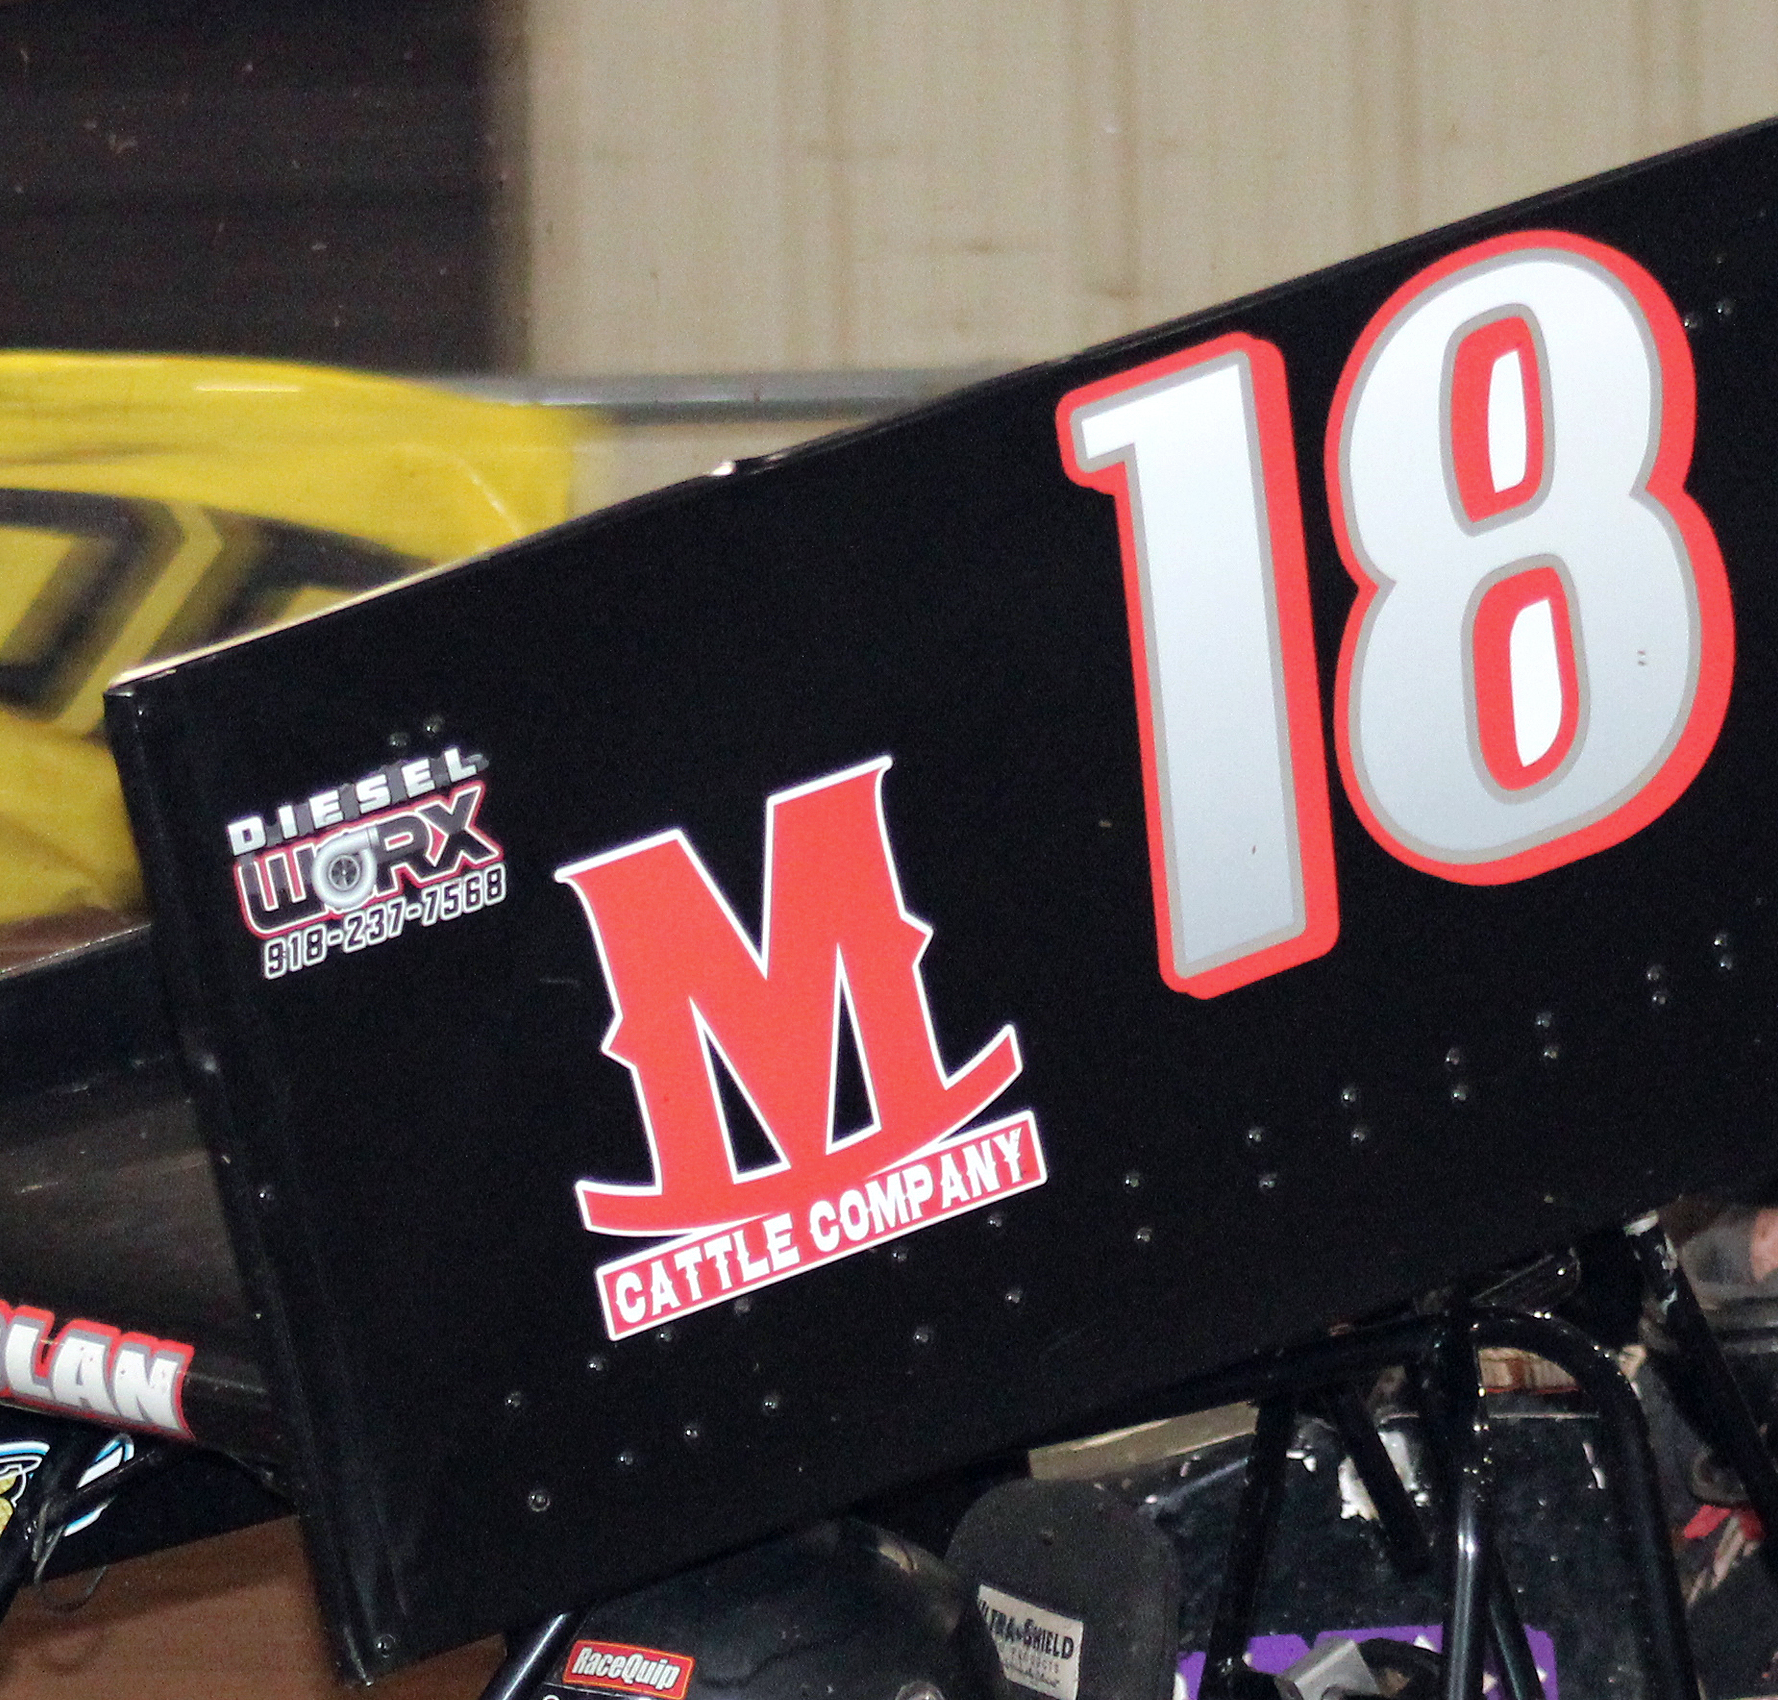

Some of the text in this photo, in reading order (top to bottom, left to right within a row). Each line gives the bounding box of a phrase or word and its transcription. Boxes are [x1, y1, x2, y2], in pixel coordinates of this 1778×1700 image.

[1055, 229, 1736, 999] 18
[228, 747, 484, 857] DIESEL
[235, 781, 504, 938] WORX
[263, 862, 507, 980] 918-237-7568
[555, 755, 1022, 1237] M
[615, 1126, 1027, 1326] CATTLE COMPANY
[571, 1646, 682, 1691] RaceQuip
